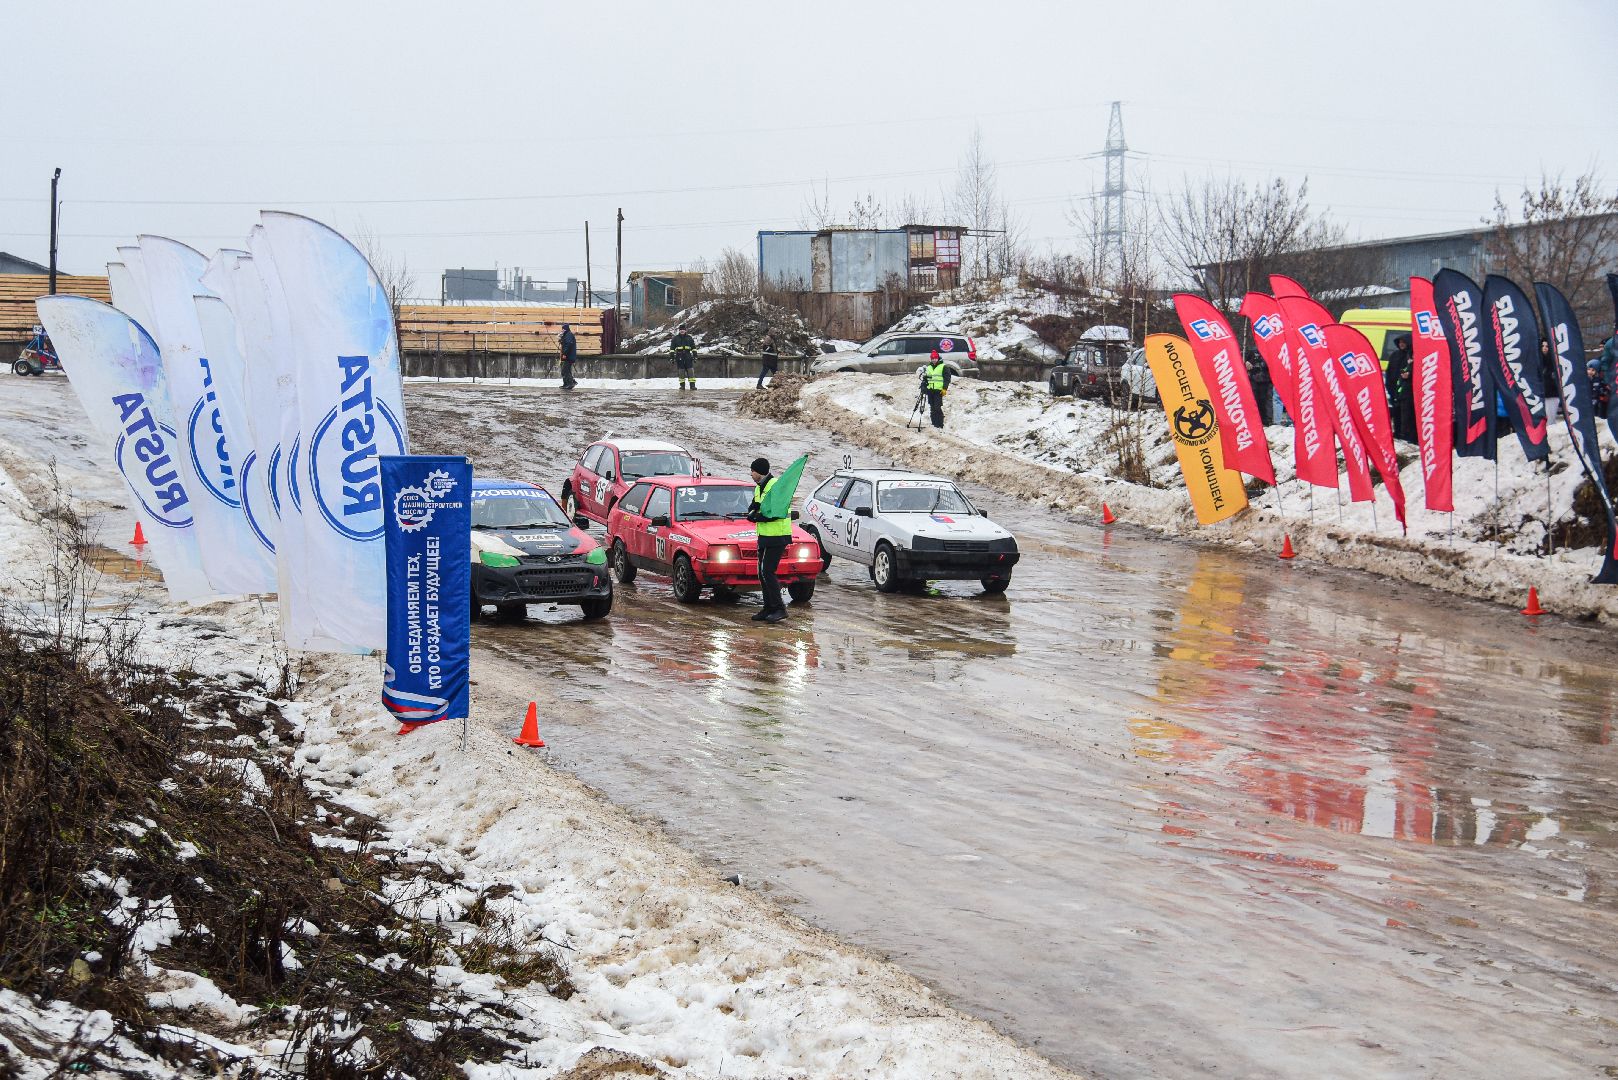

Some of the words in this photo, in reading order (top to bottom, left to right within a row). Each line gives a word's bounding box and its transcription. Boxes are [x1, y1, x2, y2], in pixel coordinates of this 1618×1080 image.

[842, 454, 852, 470] 92
[846, 517, 860, 547] 92
[656, 537, 665, 559] 79
[407, 552, 422, 578] ТЕХ,
[426, 536, 442, 601] БУДУЩЕЕ!
[407, 582, 422, 674] ОБЪЕДИНЯЕМ
[426, 603, 442, 663] СОЗДАЕТ
[428, 665, 442, 690] КТО
